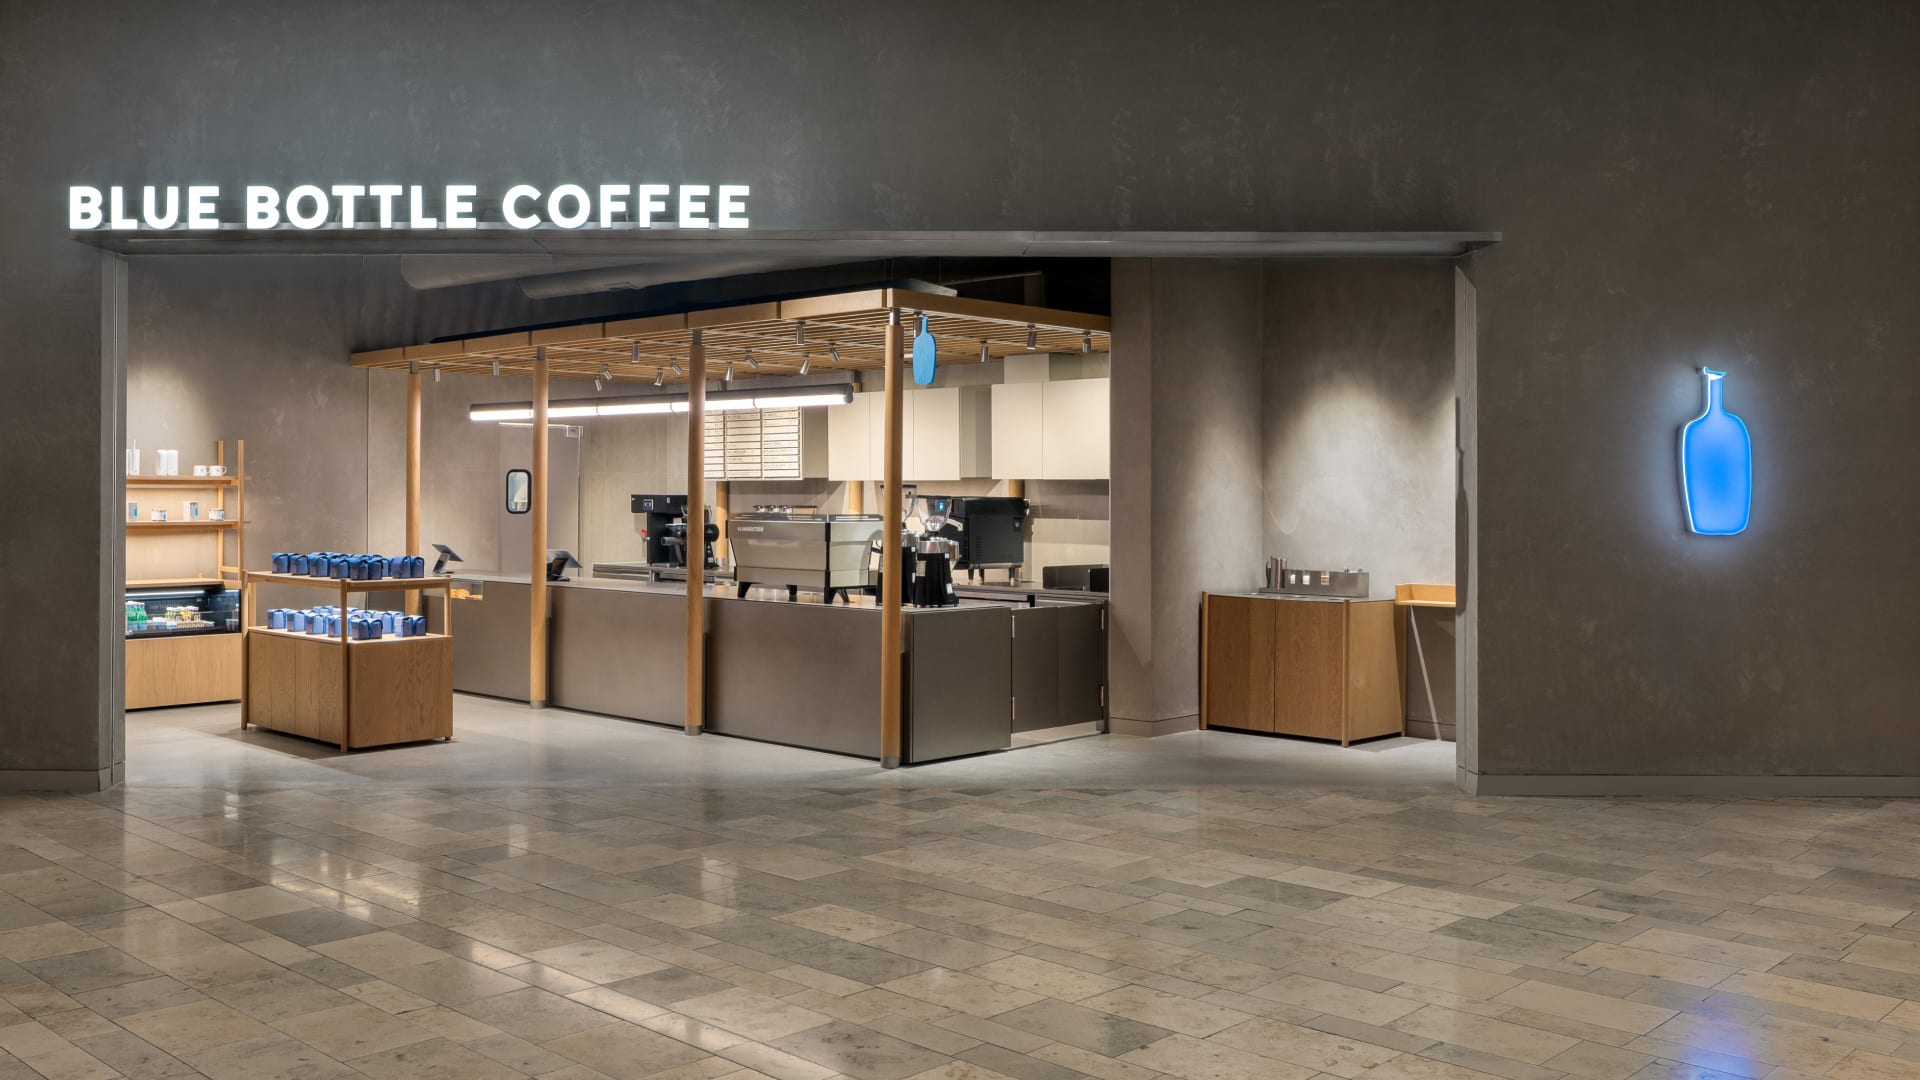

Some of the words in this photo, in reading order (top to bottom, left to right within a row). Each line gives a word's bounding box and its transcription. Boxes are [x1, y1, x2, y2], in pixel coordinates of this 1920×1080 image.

[70, 186, 219, 229] BLUE
[247, 185, 476, 229] BOTTLE
[503, 185, 749, 229] COFFEE
